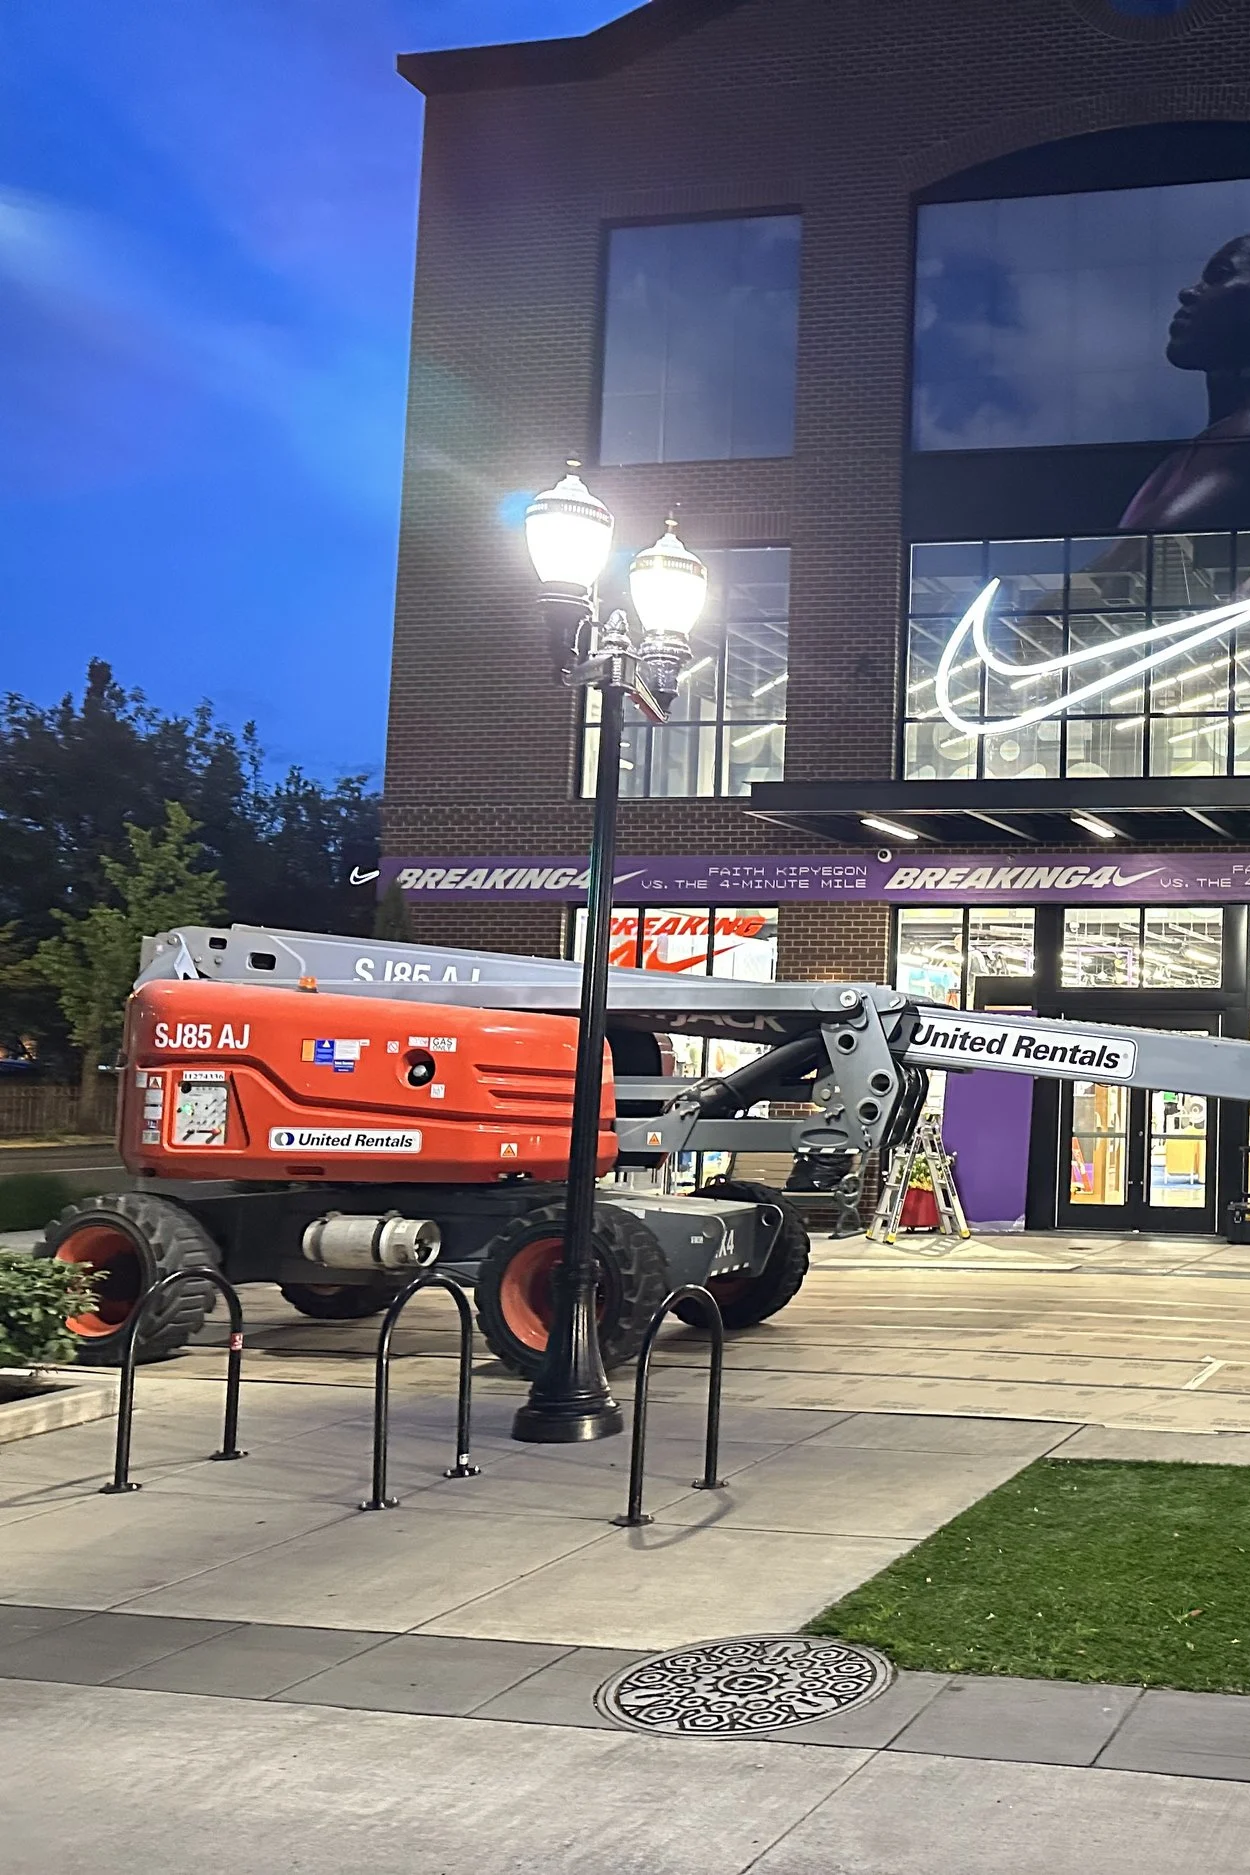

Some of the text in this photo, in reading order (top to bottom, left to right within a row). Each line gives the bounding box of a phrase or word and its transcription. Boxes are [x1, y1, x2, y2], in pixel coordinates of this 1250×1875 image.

[397, 868, 592, 890] BREAKING4
[708, 866, 867, 877] FAITH KIPYEGON
[883, 866, 1118, 890] BREAKING4
[641, 879, 867, 889] VS. THE 4-MINUTE MILE
[1160, 878, 1189, 888] VS.
[1196, 878, 1232, 888] THE
[610, 916, 767, 938] REAKING
[154, 1022, 250, 1049] SJ85 AJ
[432, 1037, 453, 1046] GAS
[909, 1021, 1121, 1070] United Rentals
[298, 1132, 413, 1148] United Rentals
